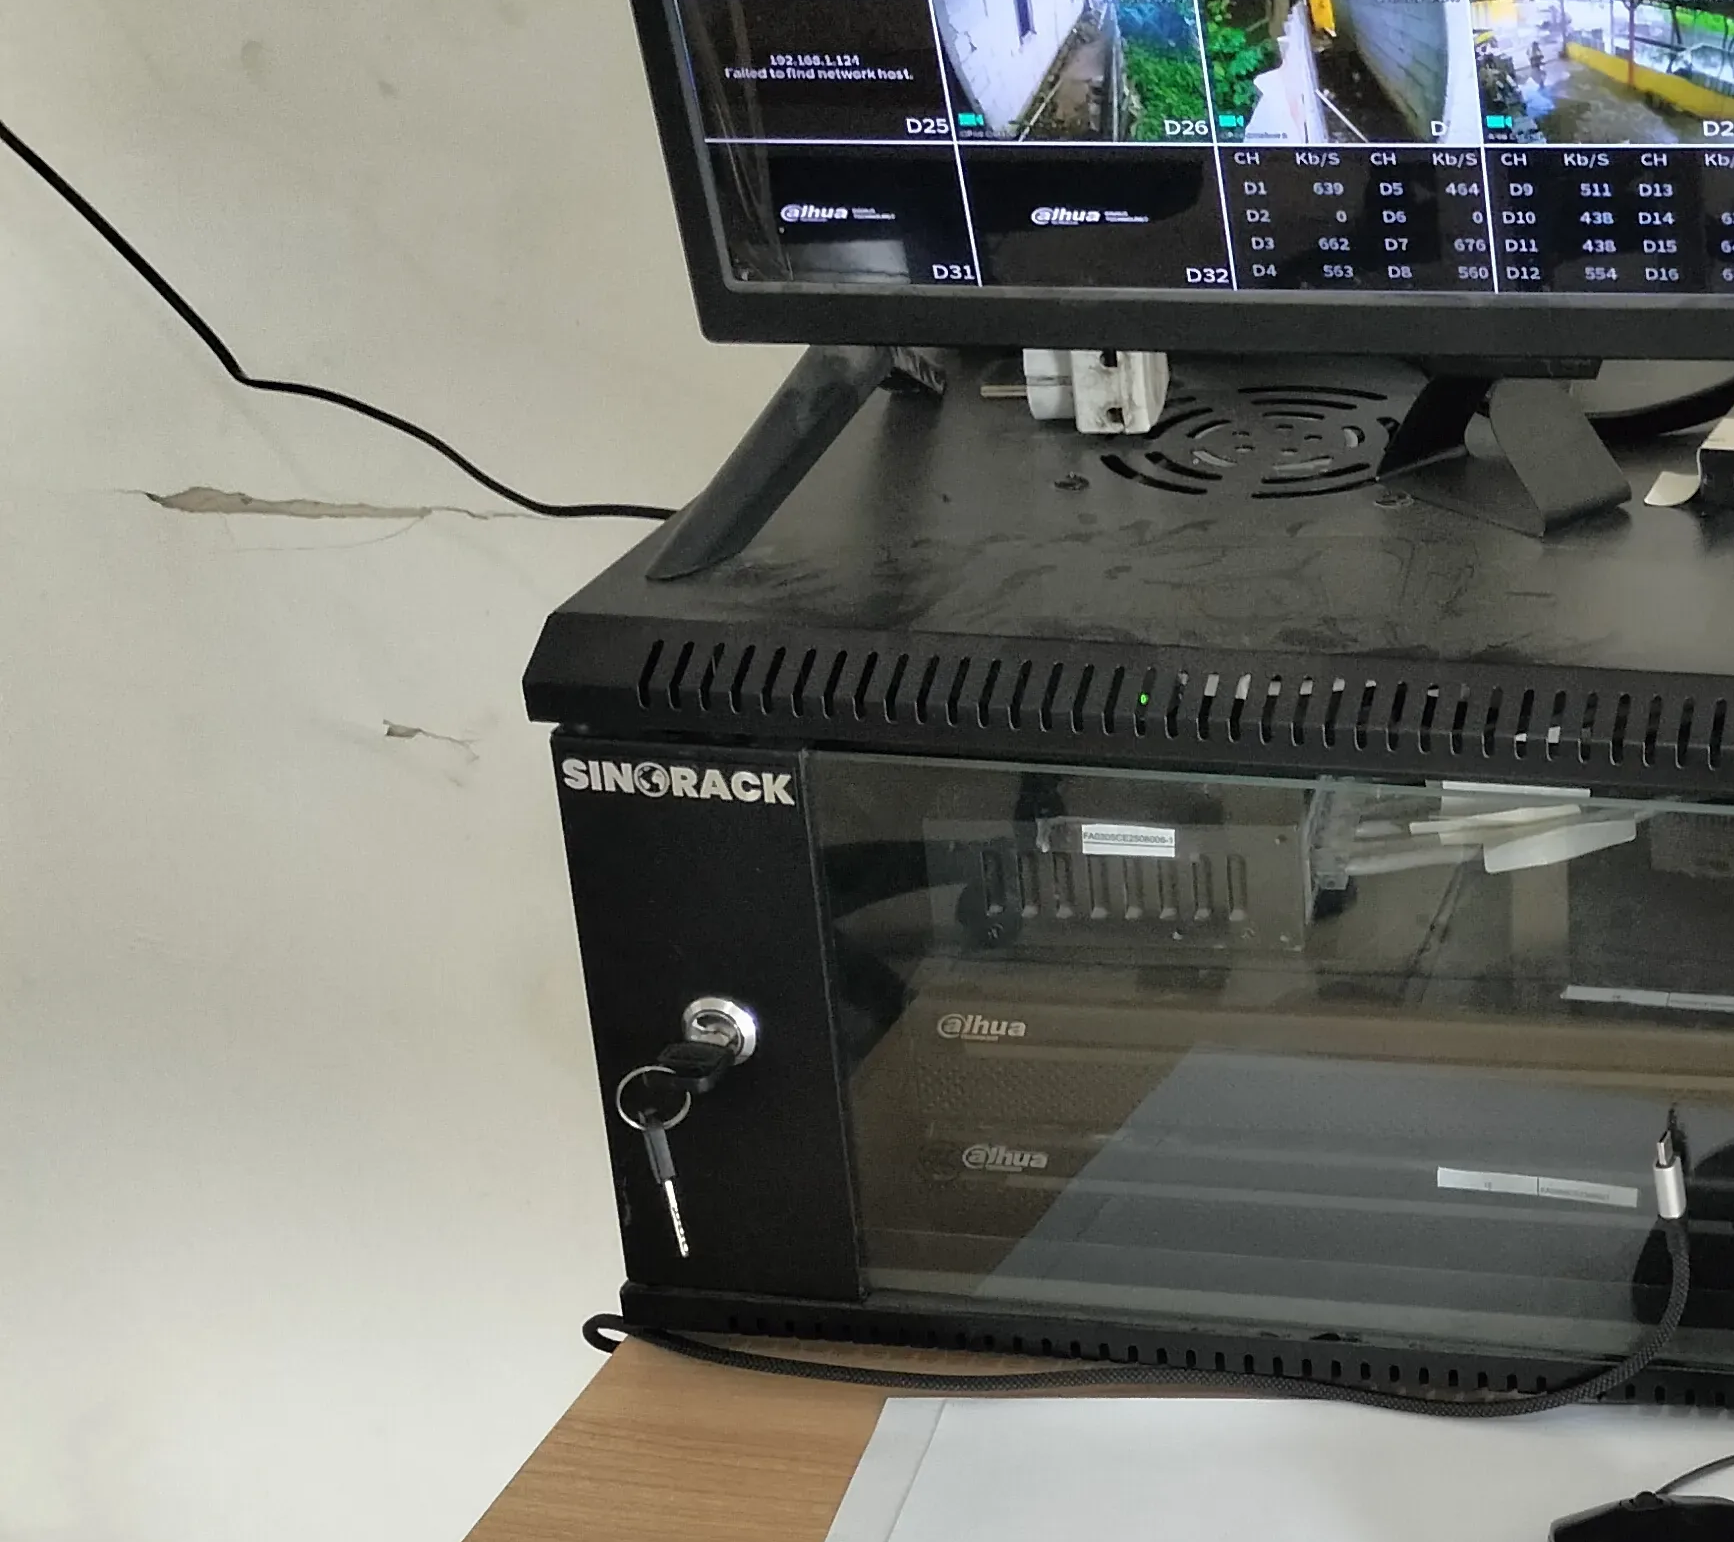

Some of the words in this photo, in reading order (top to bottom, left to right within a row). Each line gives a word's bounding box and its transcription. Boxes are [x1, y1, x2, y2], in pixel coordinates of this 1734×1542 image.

[906, 119, 948, 133] D25
[1164, 120, 1208, 135] D26
[933, 265, 974, 279] D31
[1187, 268, 1228, 282] D32
